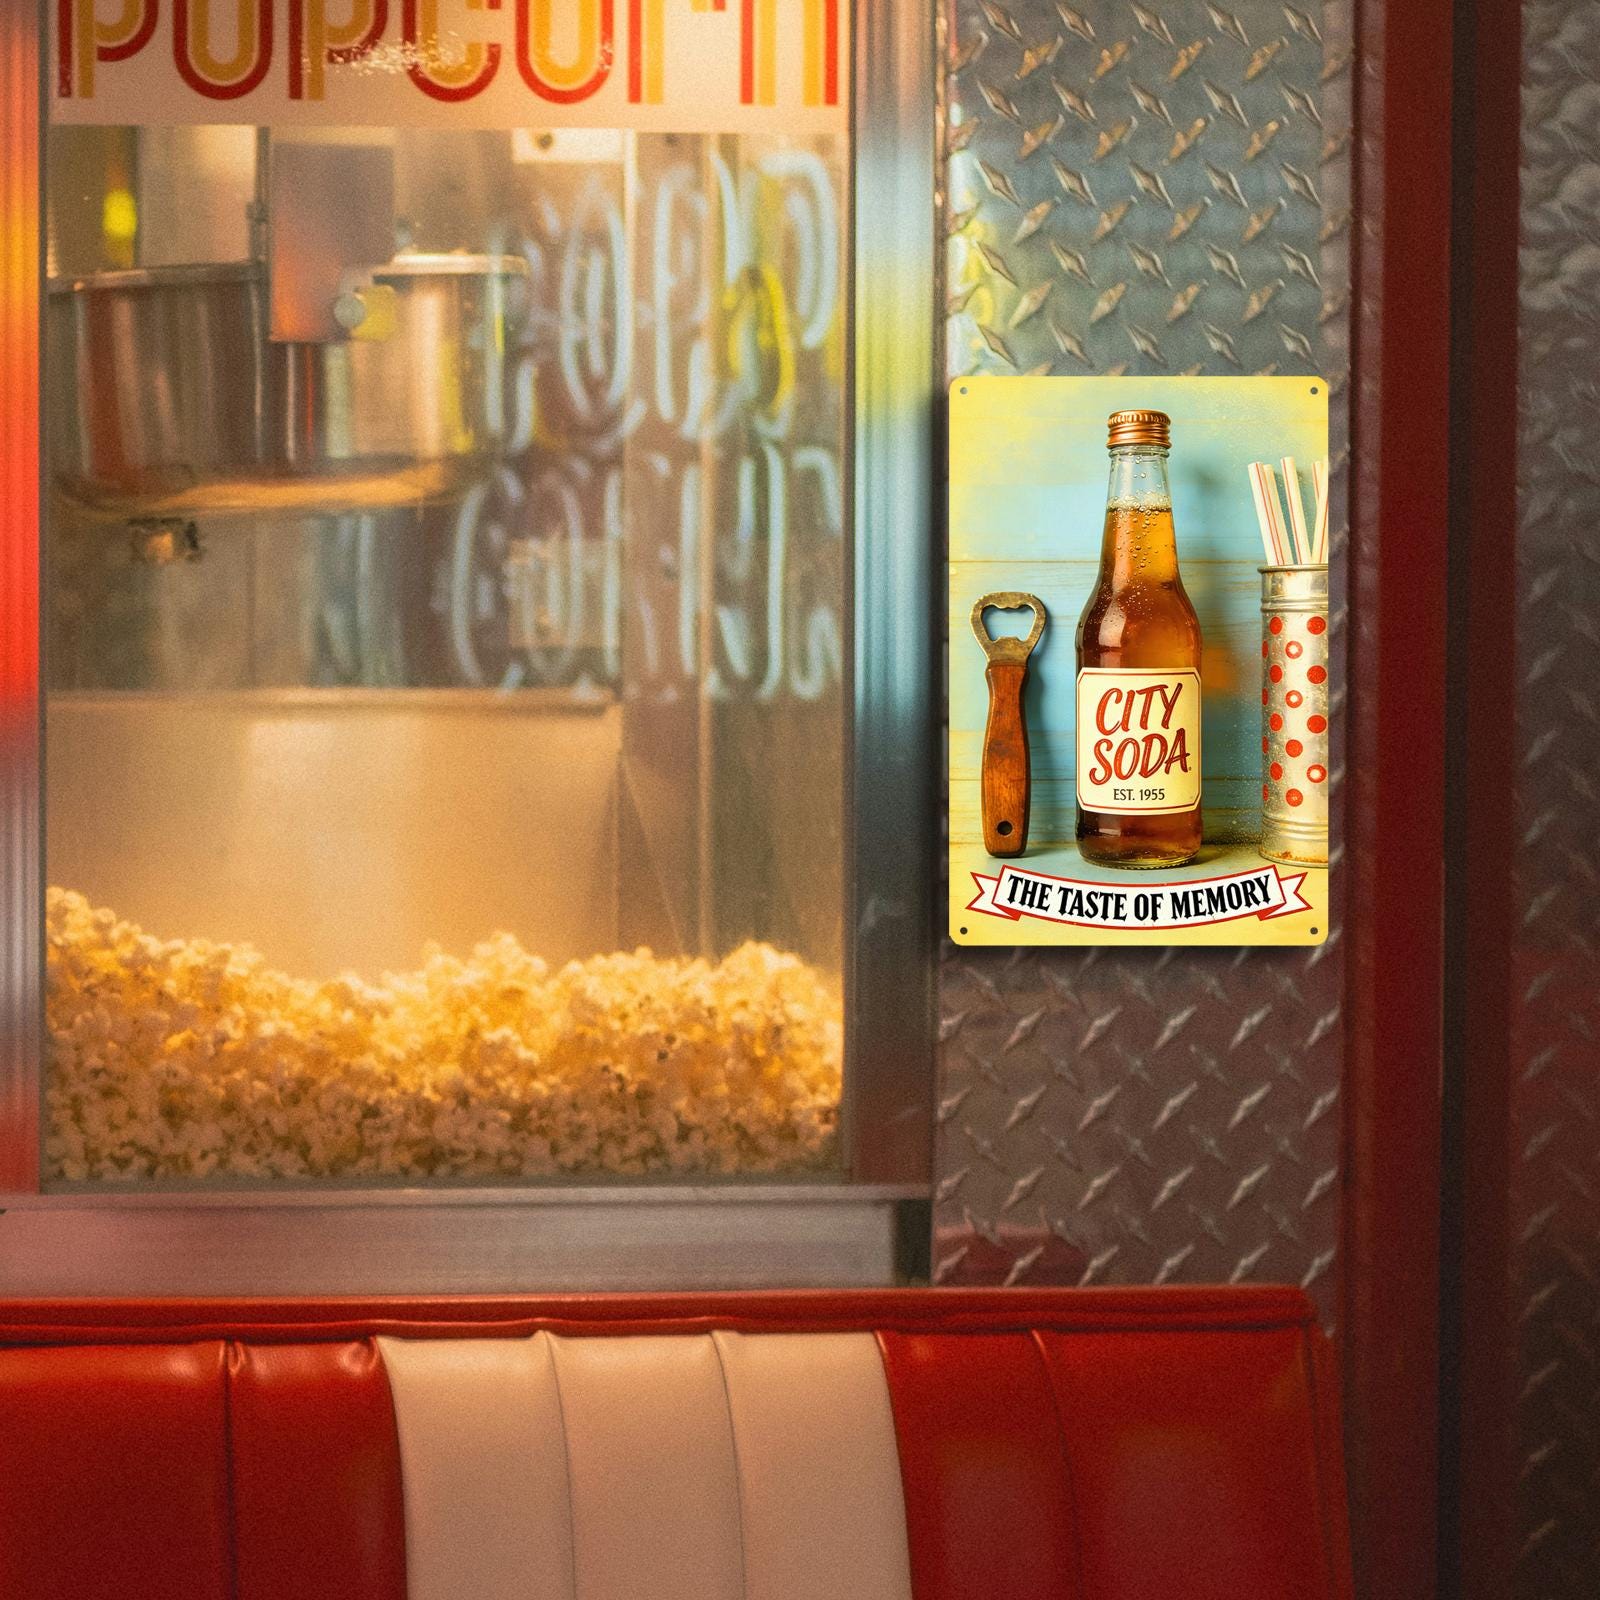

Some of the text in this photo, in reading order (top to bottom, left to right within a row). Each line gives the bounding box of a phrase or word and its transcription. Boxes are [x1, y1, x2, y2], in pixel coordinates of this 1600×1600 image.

[1095, 682, 1183, 736] CITY
[1113, 788, 1165, 801] EST. 1955
[1006, 873, 1271, 922] THE TASTE OF MEMORY
